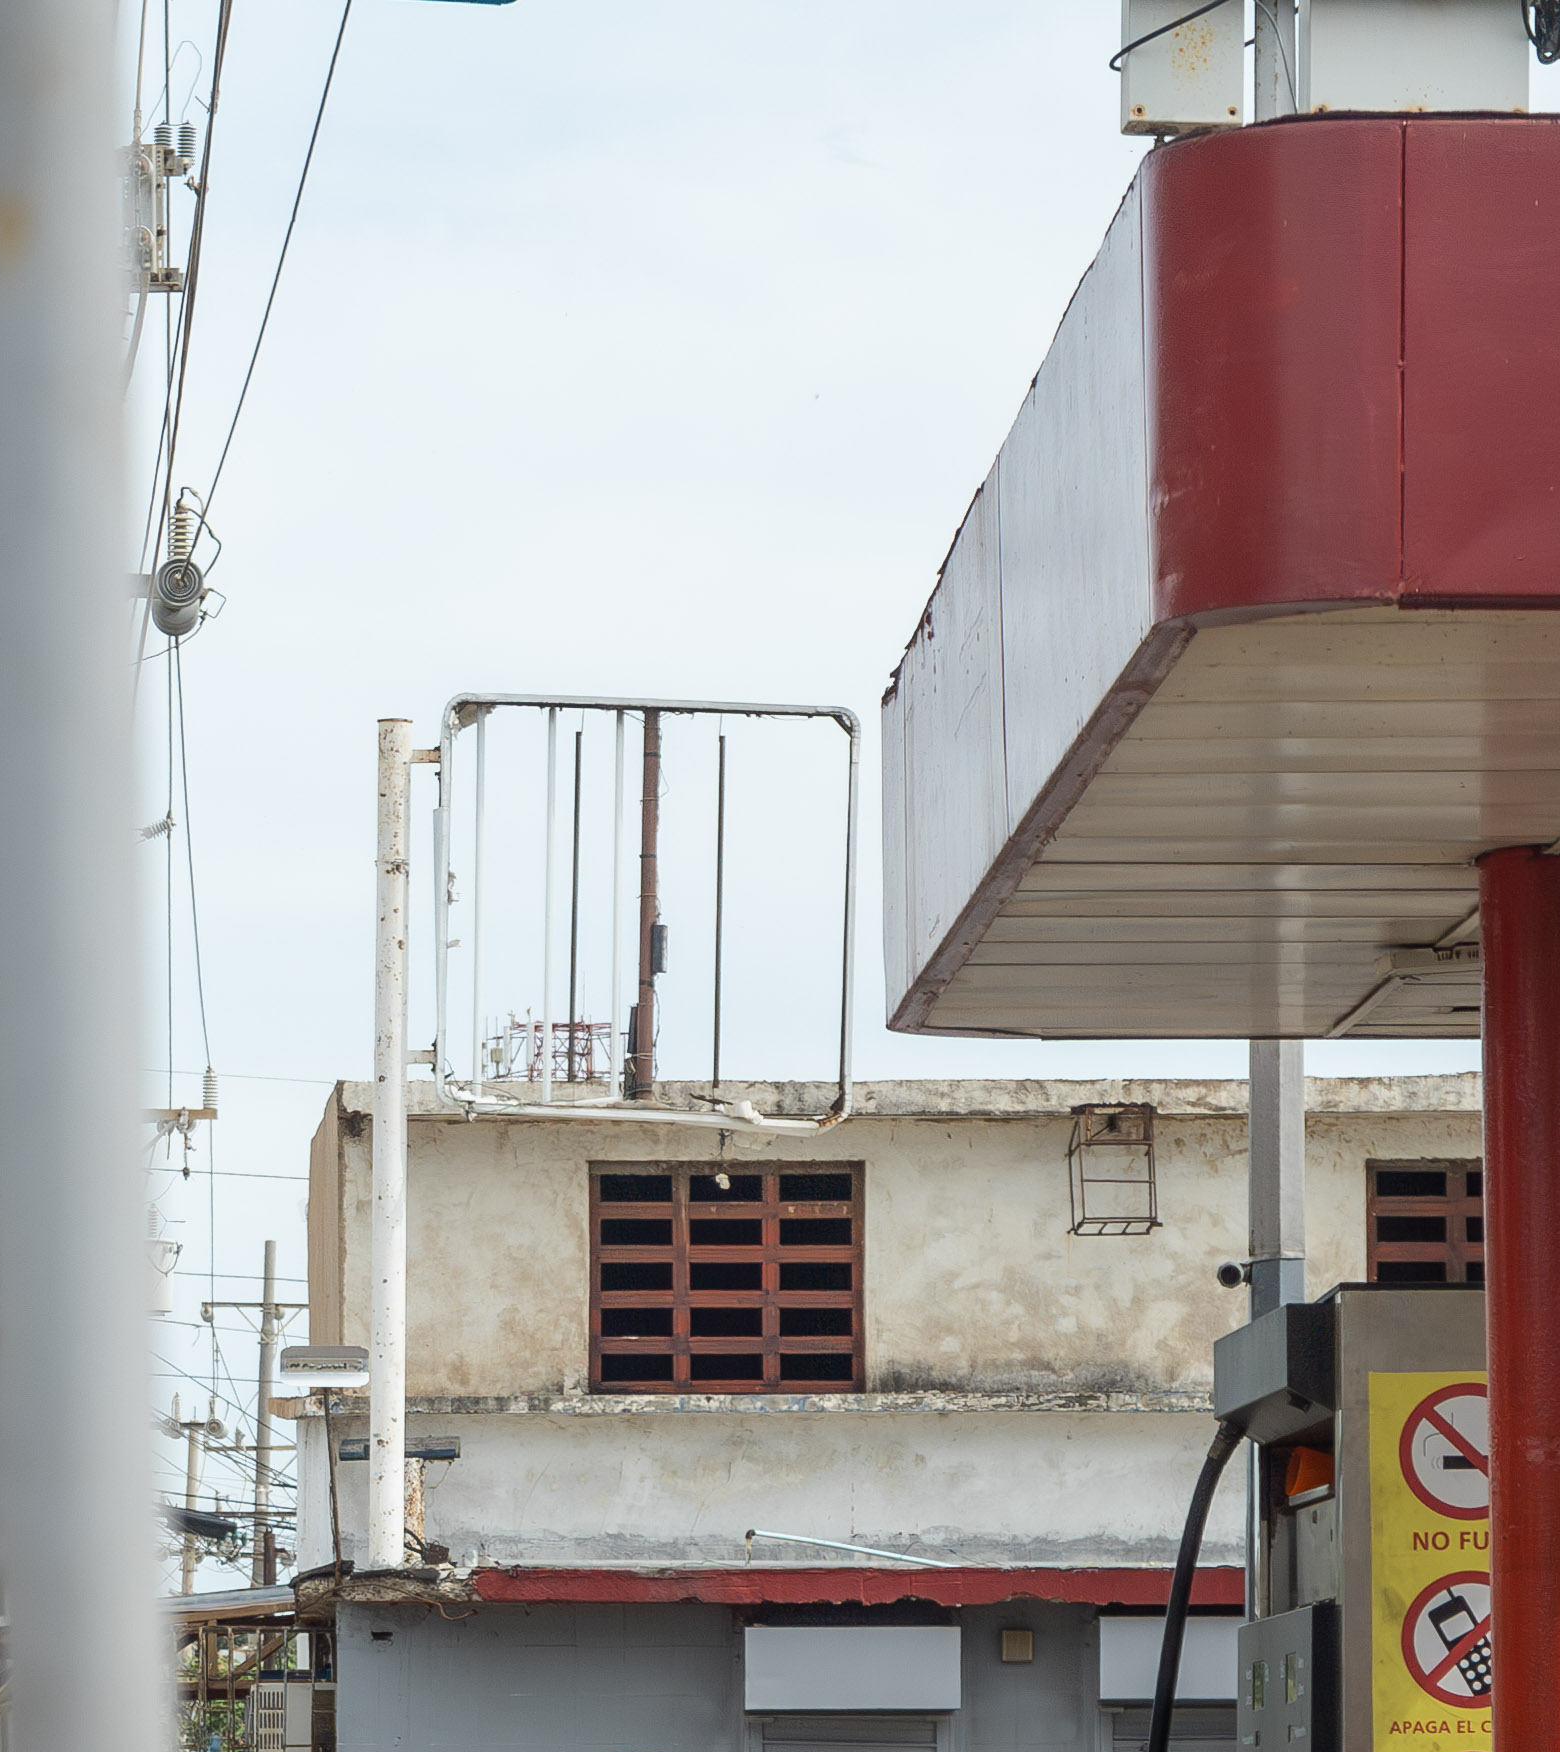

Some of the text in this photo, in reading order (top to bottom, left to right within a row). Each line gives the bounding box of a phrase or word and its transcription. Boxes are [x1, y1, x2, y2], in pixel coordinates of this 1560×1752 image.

[1412, 1531, 1450, 1551] NO
[1389, 1720, 1451, 1734] APAGA
[1456, 1720, 1475, 1733] EL
